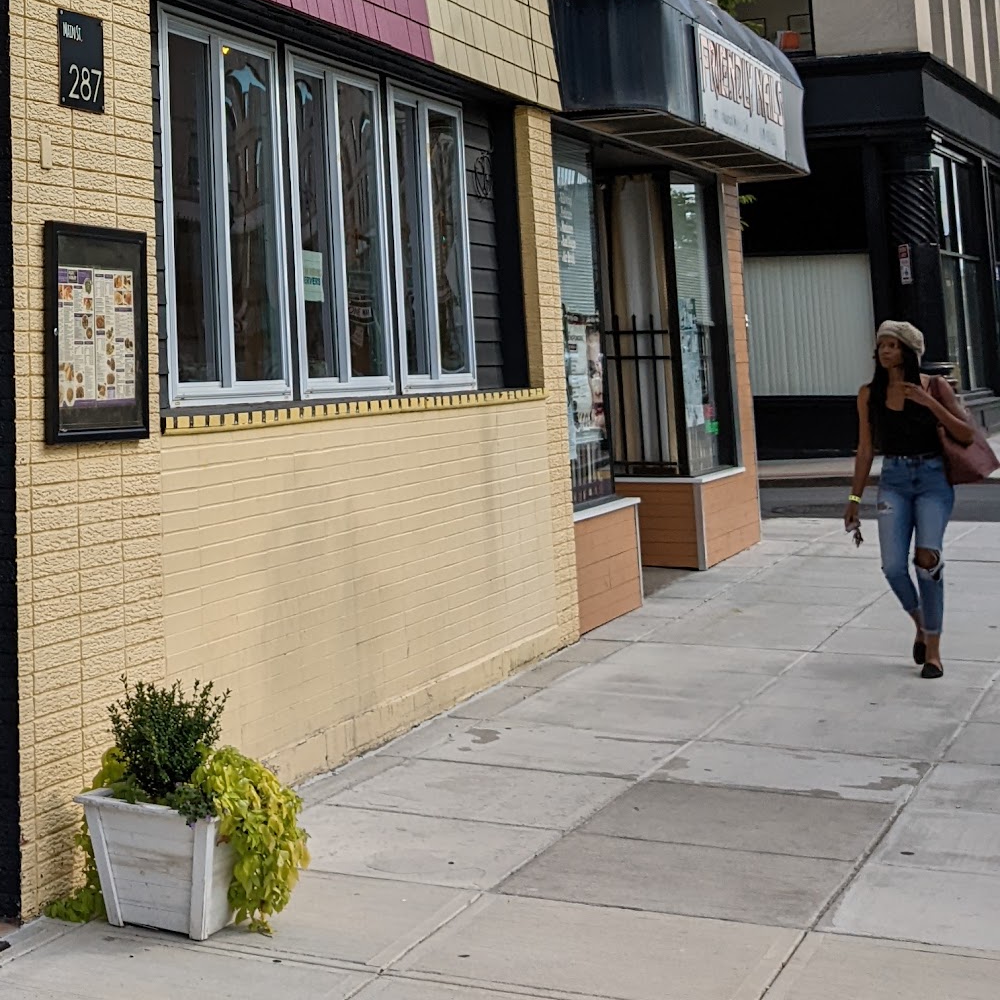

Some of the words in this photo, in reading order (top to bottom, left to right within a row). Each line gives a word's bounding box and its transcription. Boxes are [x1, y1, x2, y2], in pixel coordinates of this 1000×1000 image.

[69, 63, 102, 103] 287
[699, 33, 754, 118] FRIENDLY
[755, 67, 783, 127] NAILS
